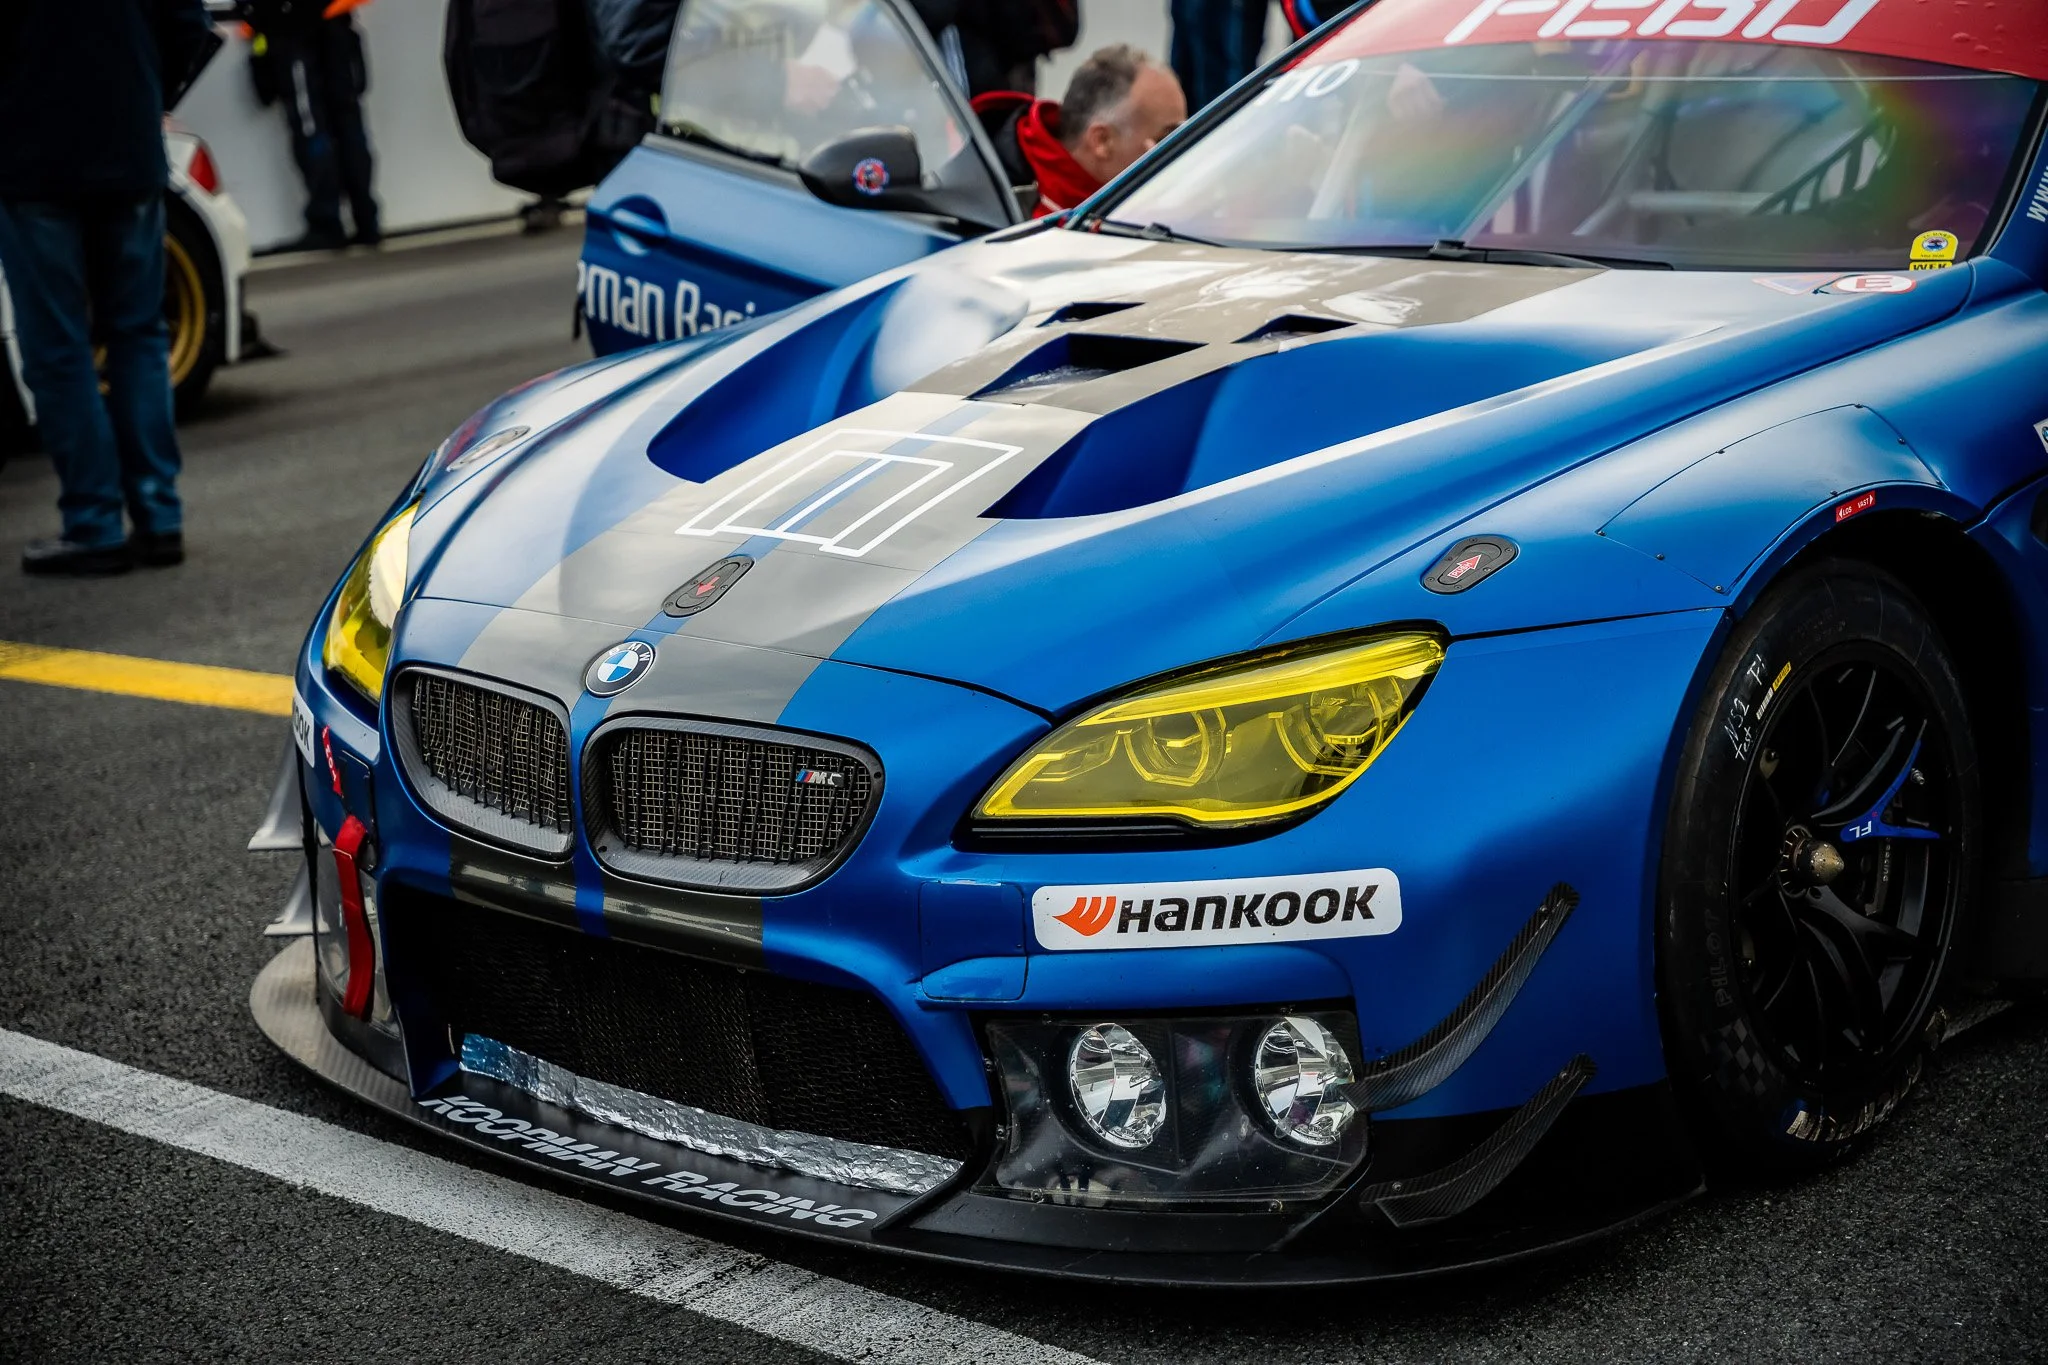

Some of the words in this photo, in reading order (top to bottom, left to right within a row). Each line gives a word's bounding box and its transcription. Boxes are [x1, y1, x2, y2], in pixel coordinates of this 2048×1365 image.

[1849, 820, 1873, 838] FL
[418, 1094, 661, 1177] KOOPMAN
[642, 1170, 878, 1229] RACING
